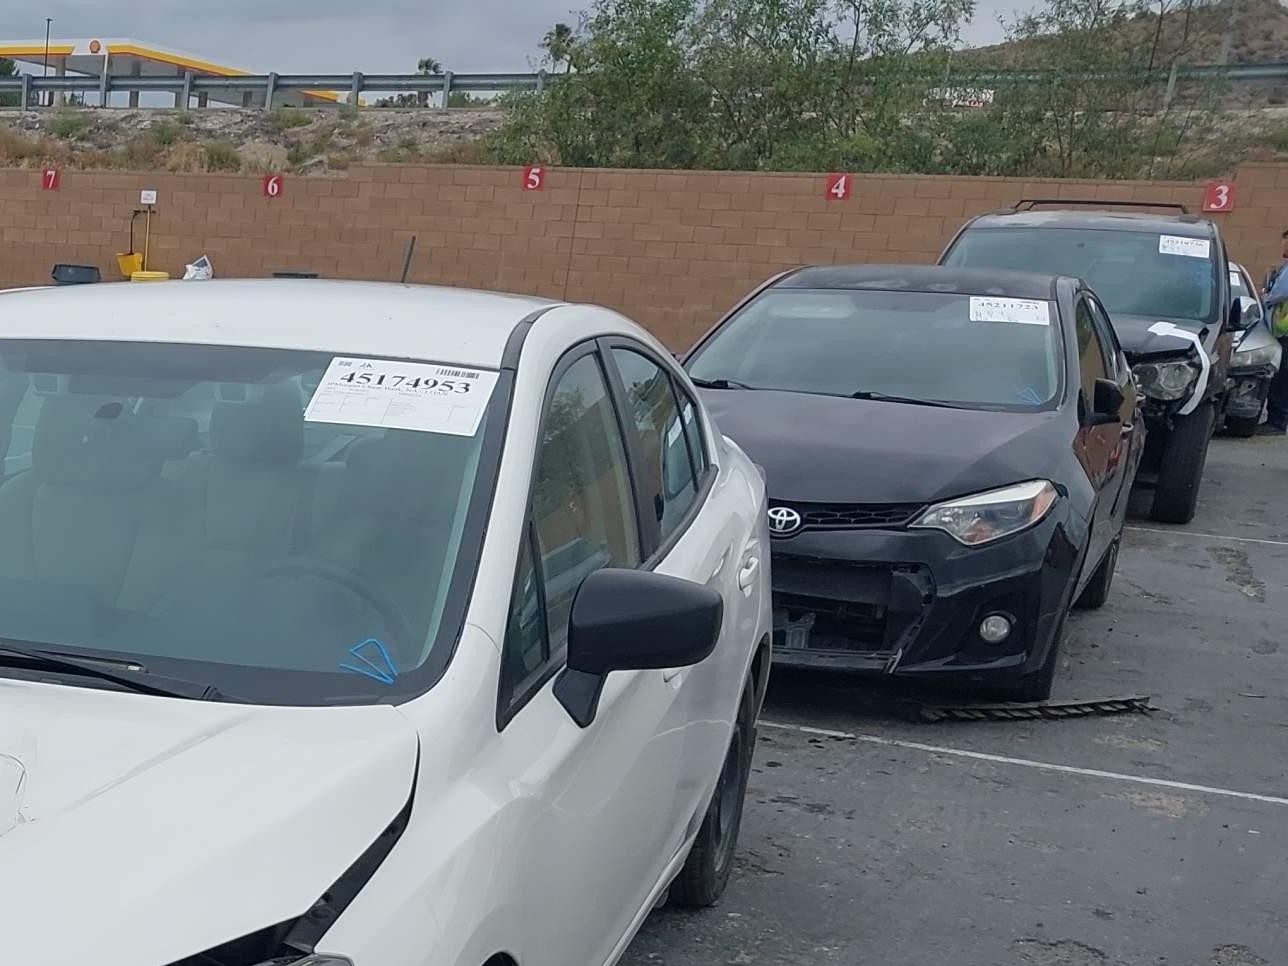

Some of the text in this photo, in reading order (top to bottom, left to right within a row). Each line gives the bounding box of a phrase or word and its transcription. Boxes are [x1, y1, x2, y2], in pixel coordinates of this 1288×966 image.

[46, 170, 56, 189] 7
[267, 175, 279, 195] 6
[527, 167, 541, 189] 5
[830, 175, 846, 198] 4
[1210, 185, 1229, 209] 3
[340, 371, 473, 395] 45174953
